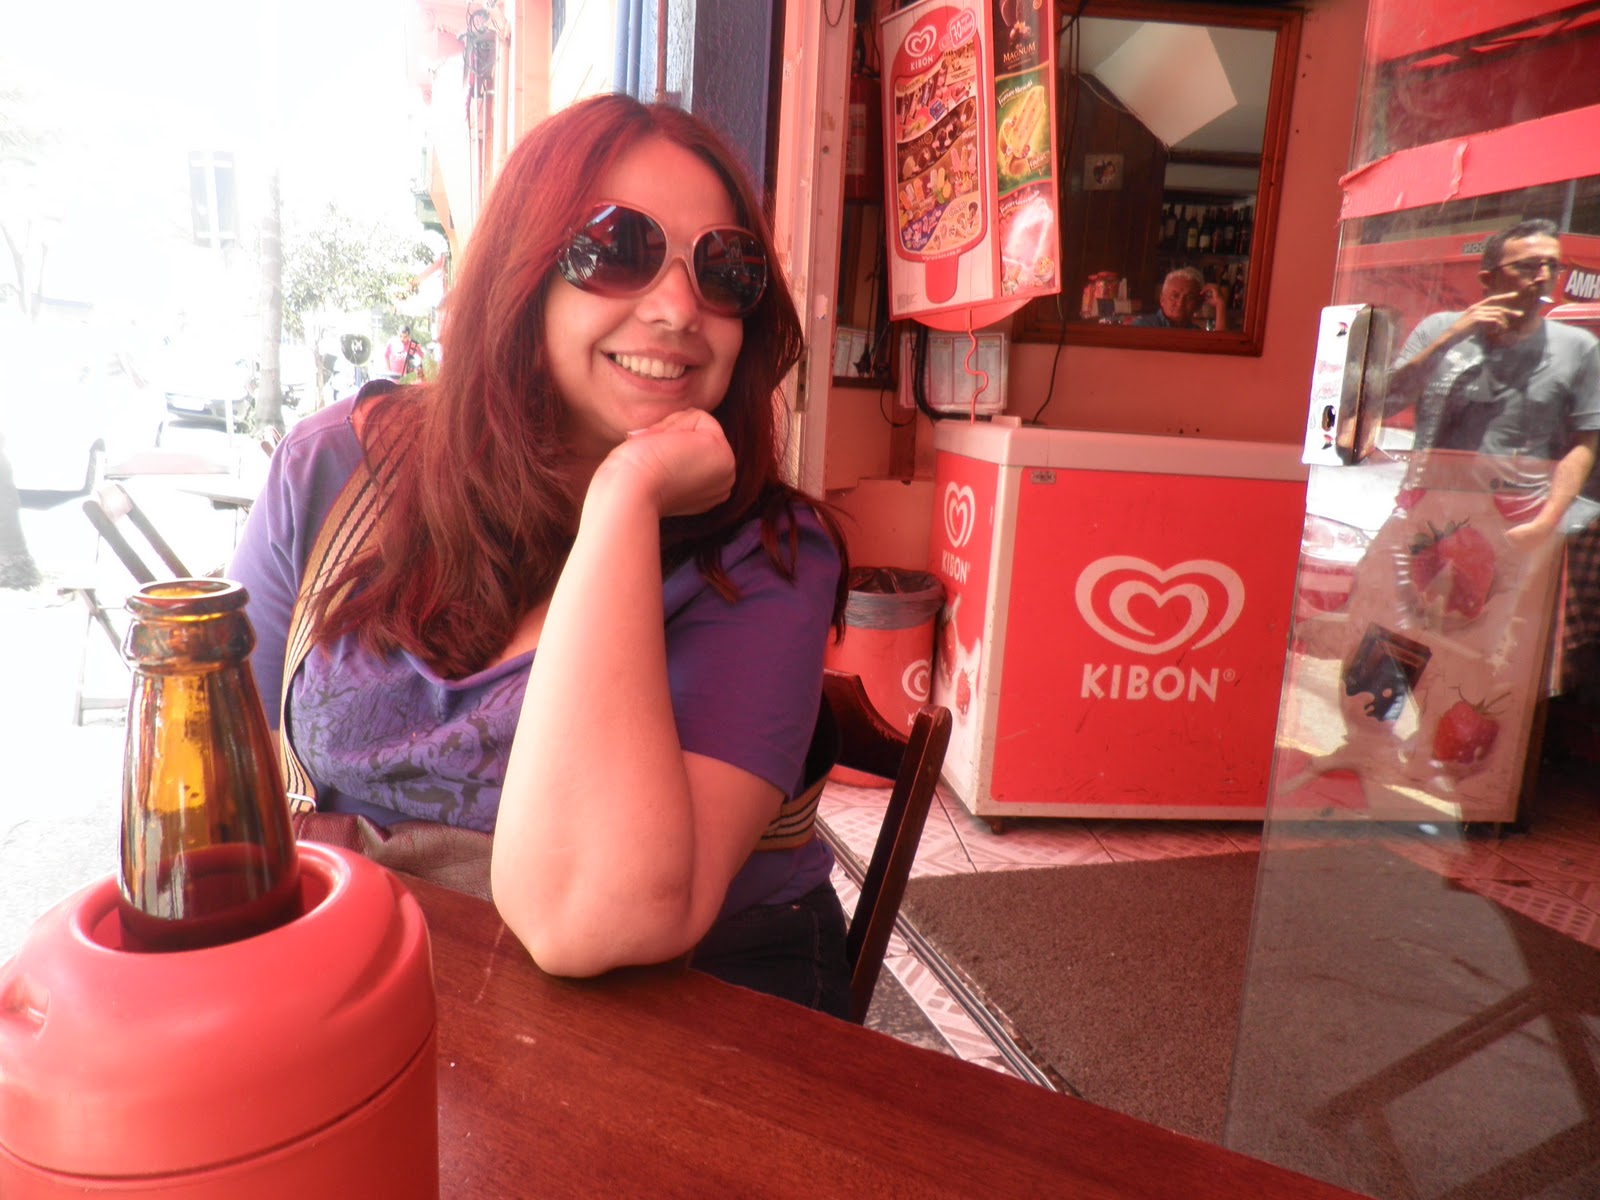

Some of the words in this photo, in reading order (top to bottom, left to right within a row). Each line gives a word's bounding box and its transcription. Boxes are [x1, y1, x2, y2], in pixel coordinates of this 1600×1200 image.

[910, 55, 933, 71] KIBON
[1003, 41, 1036, 63] MAGNUM
[941, 549, 967, 585] KIBON
